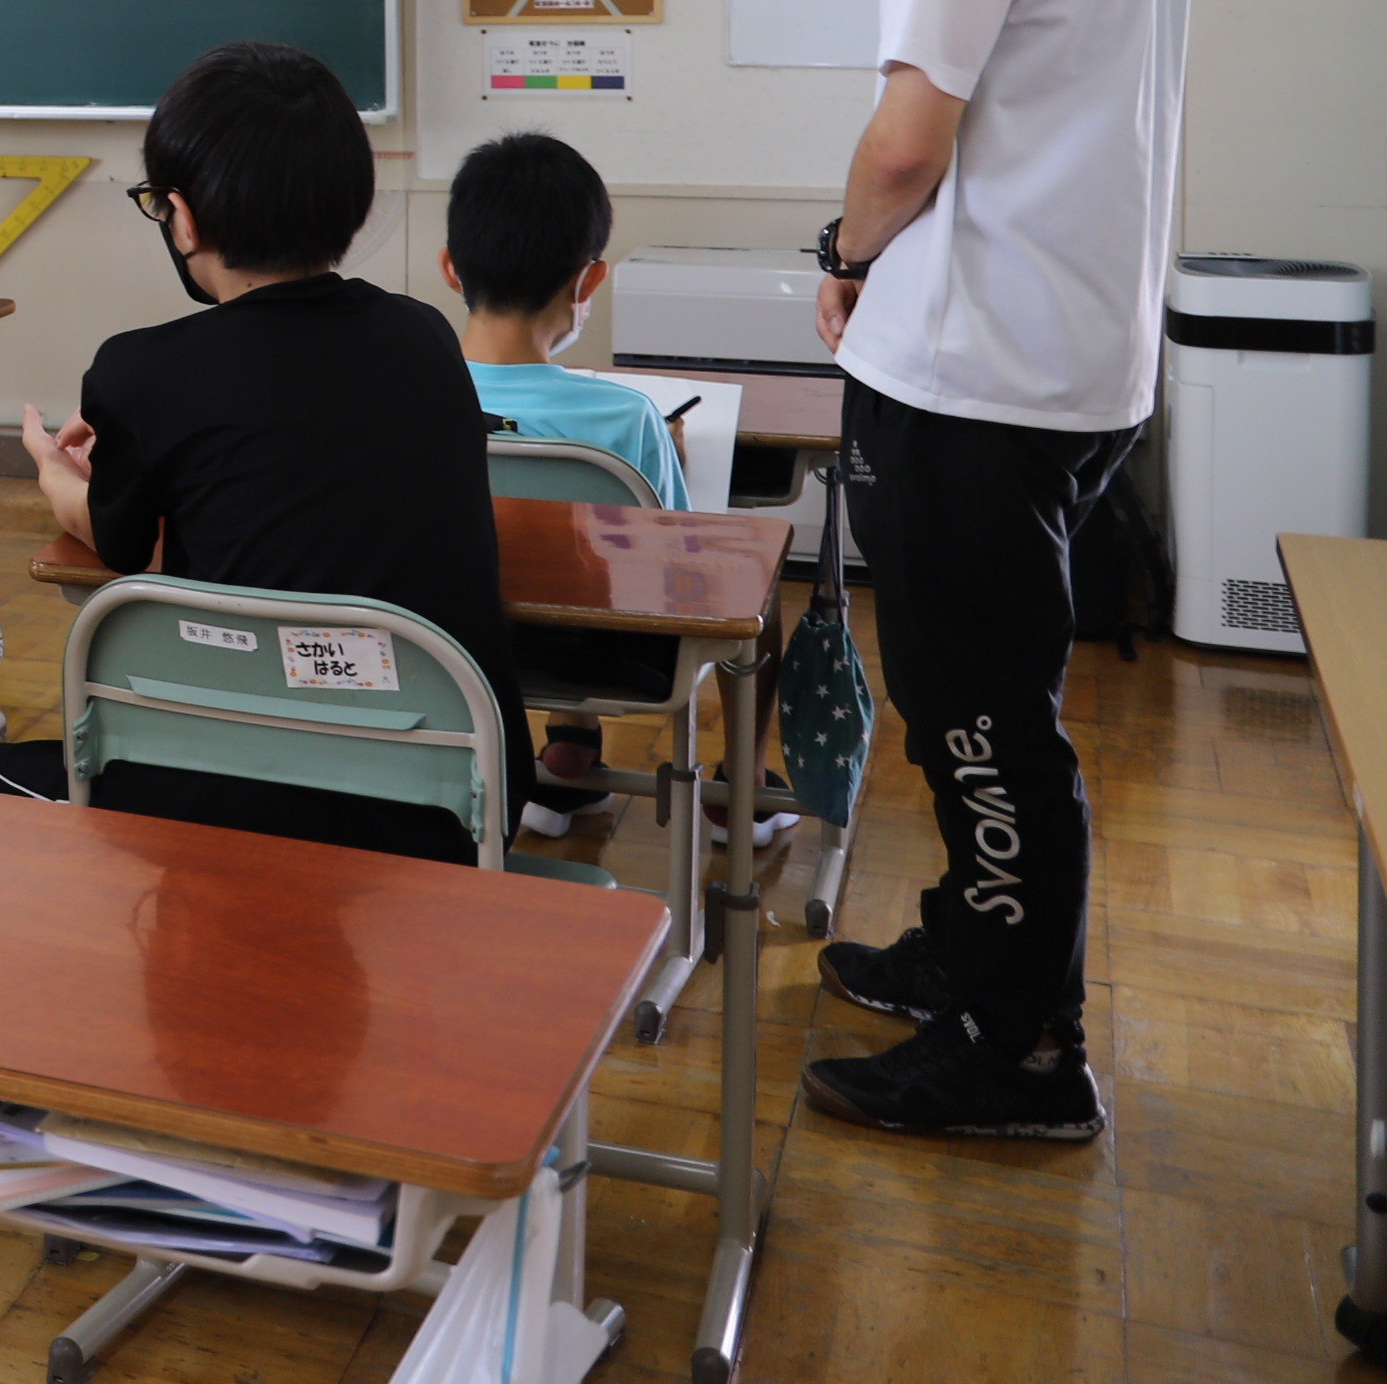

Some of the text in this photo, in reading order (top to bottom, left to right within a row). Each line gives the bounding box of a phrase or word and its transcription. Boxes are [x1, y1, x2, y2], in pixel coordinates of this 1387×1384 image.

[295, 641, 345, 659] さかい
[314, 659, 358, 677] はると
